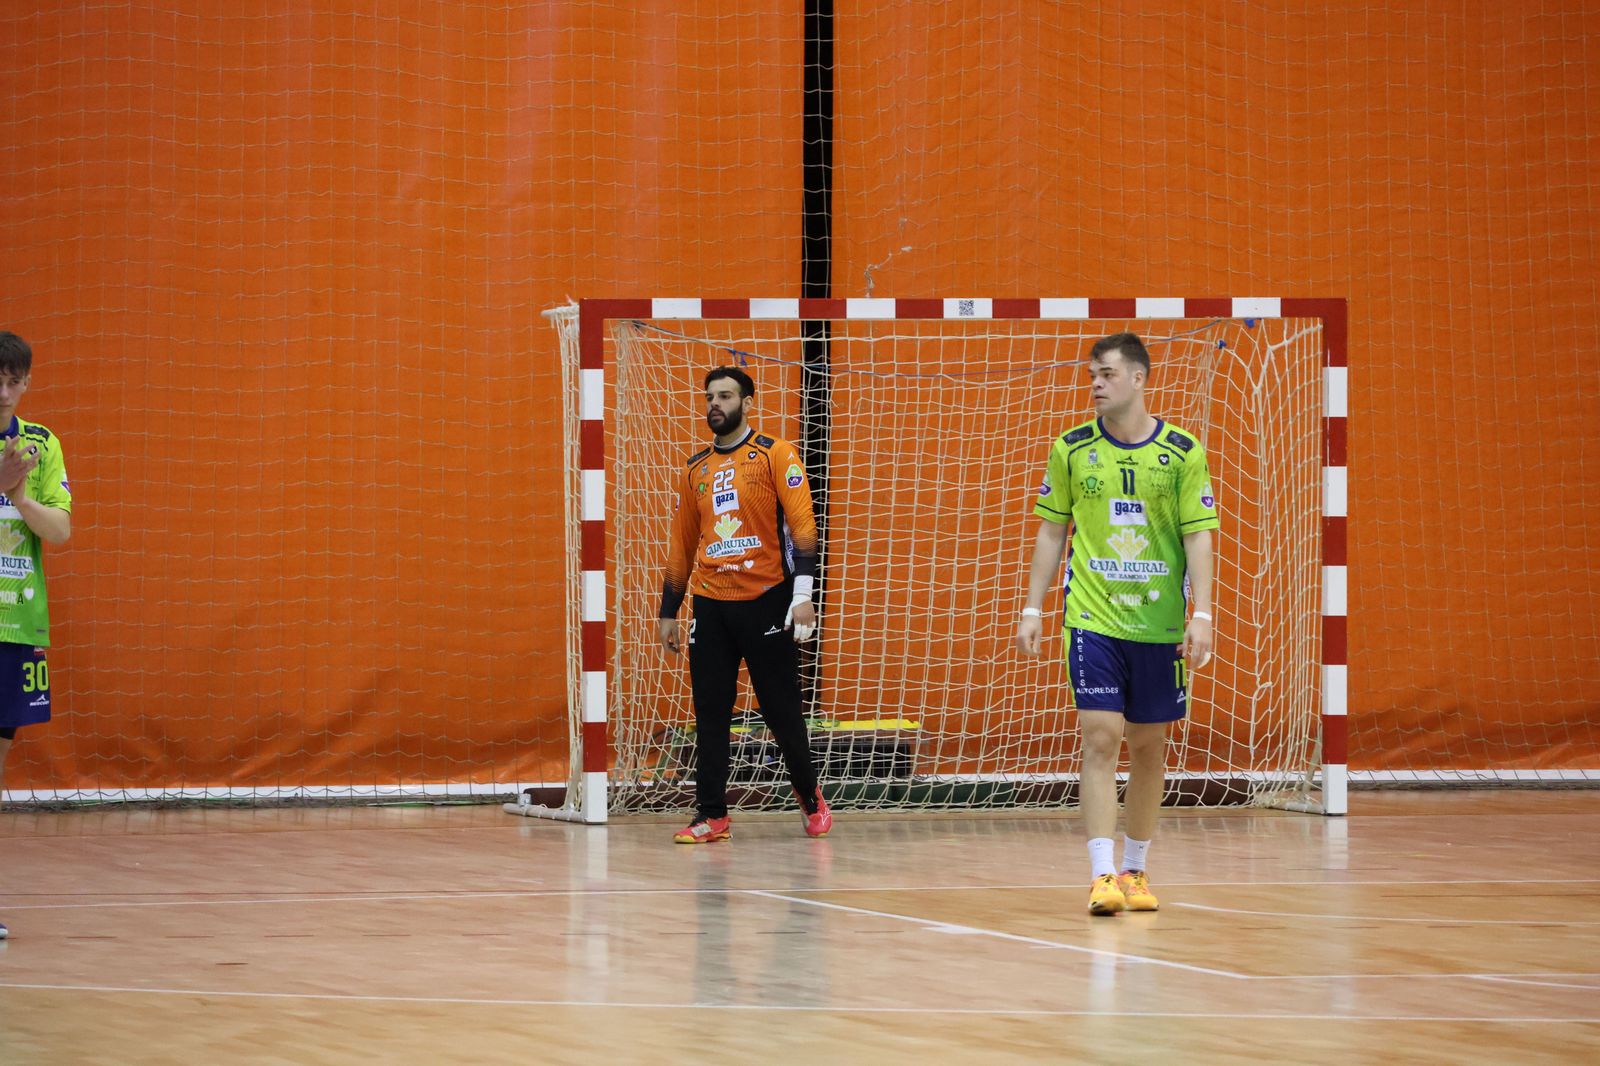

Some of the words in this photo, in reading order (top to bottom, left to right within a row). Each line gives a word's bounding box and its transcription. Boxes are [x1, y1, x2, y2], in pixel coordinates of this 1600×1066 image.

[713, 468, 735, 493] 22
[1120, 467, 1136, 496] 11
[715, 492, 735, 507] gaza
[1115, 501, 1143, 516] gaza
[723, 537, 760, 549] RURAL
[1, 556, 34, 571] RURA
[1089, 559, 1118, 571] CAJA
[1124, 562, 1167, 573] RURAL
[1105, 592, 1149, 606] ZAMORA
[22, 661, 49, 692] 30
[1173, 658, 1187, 689] 11
